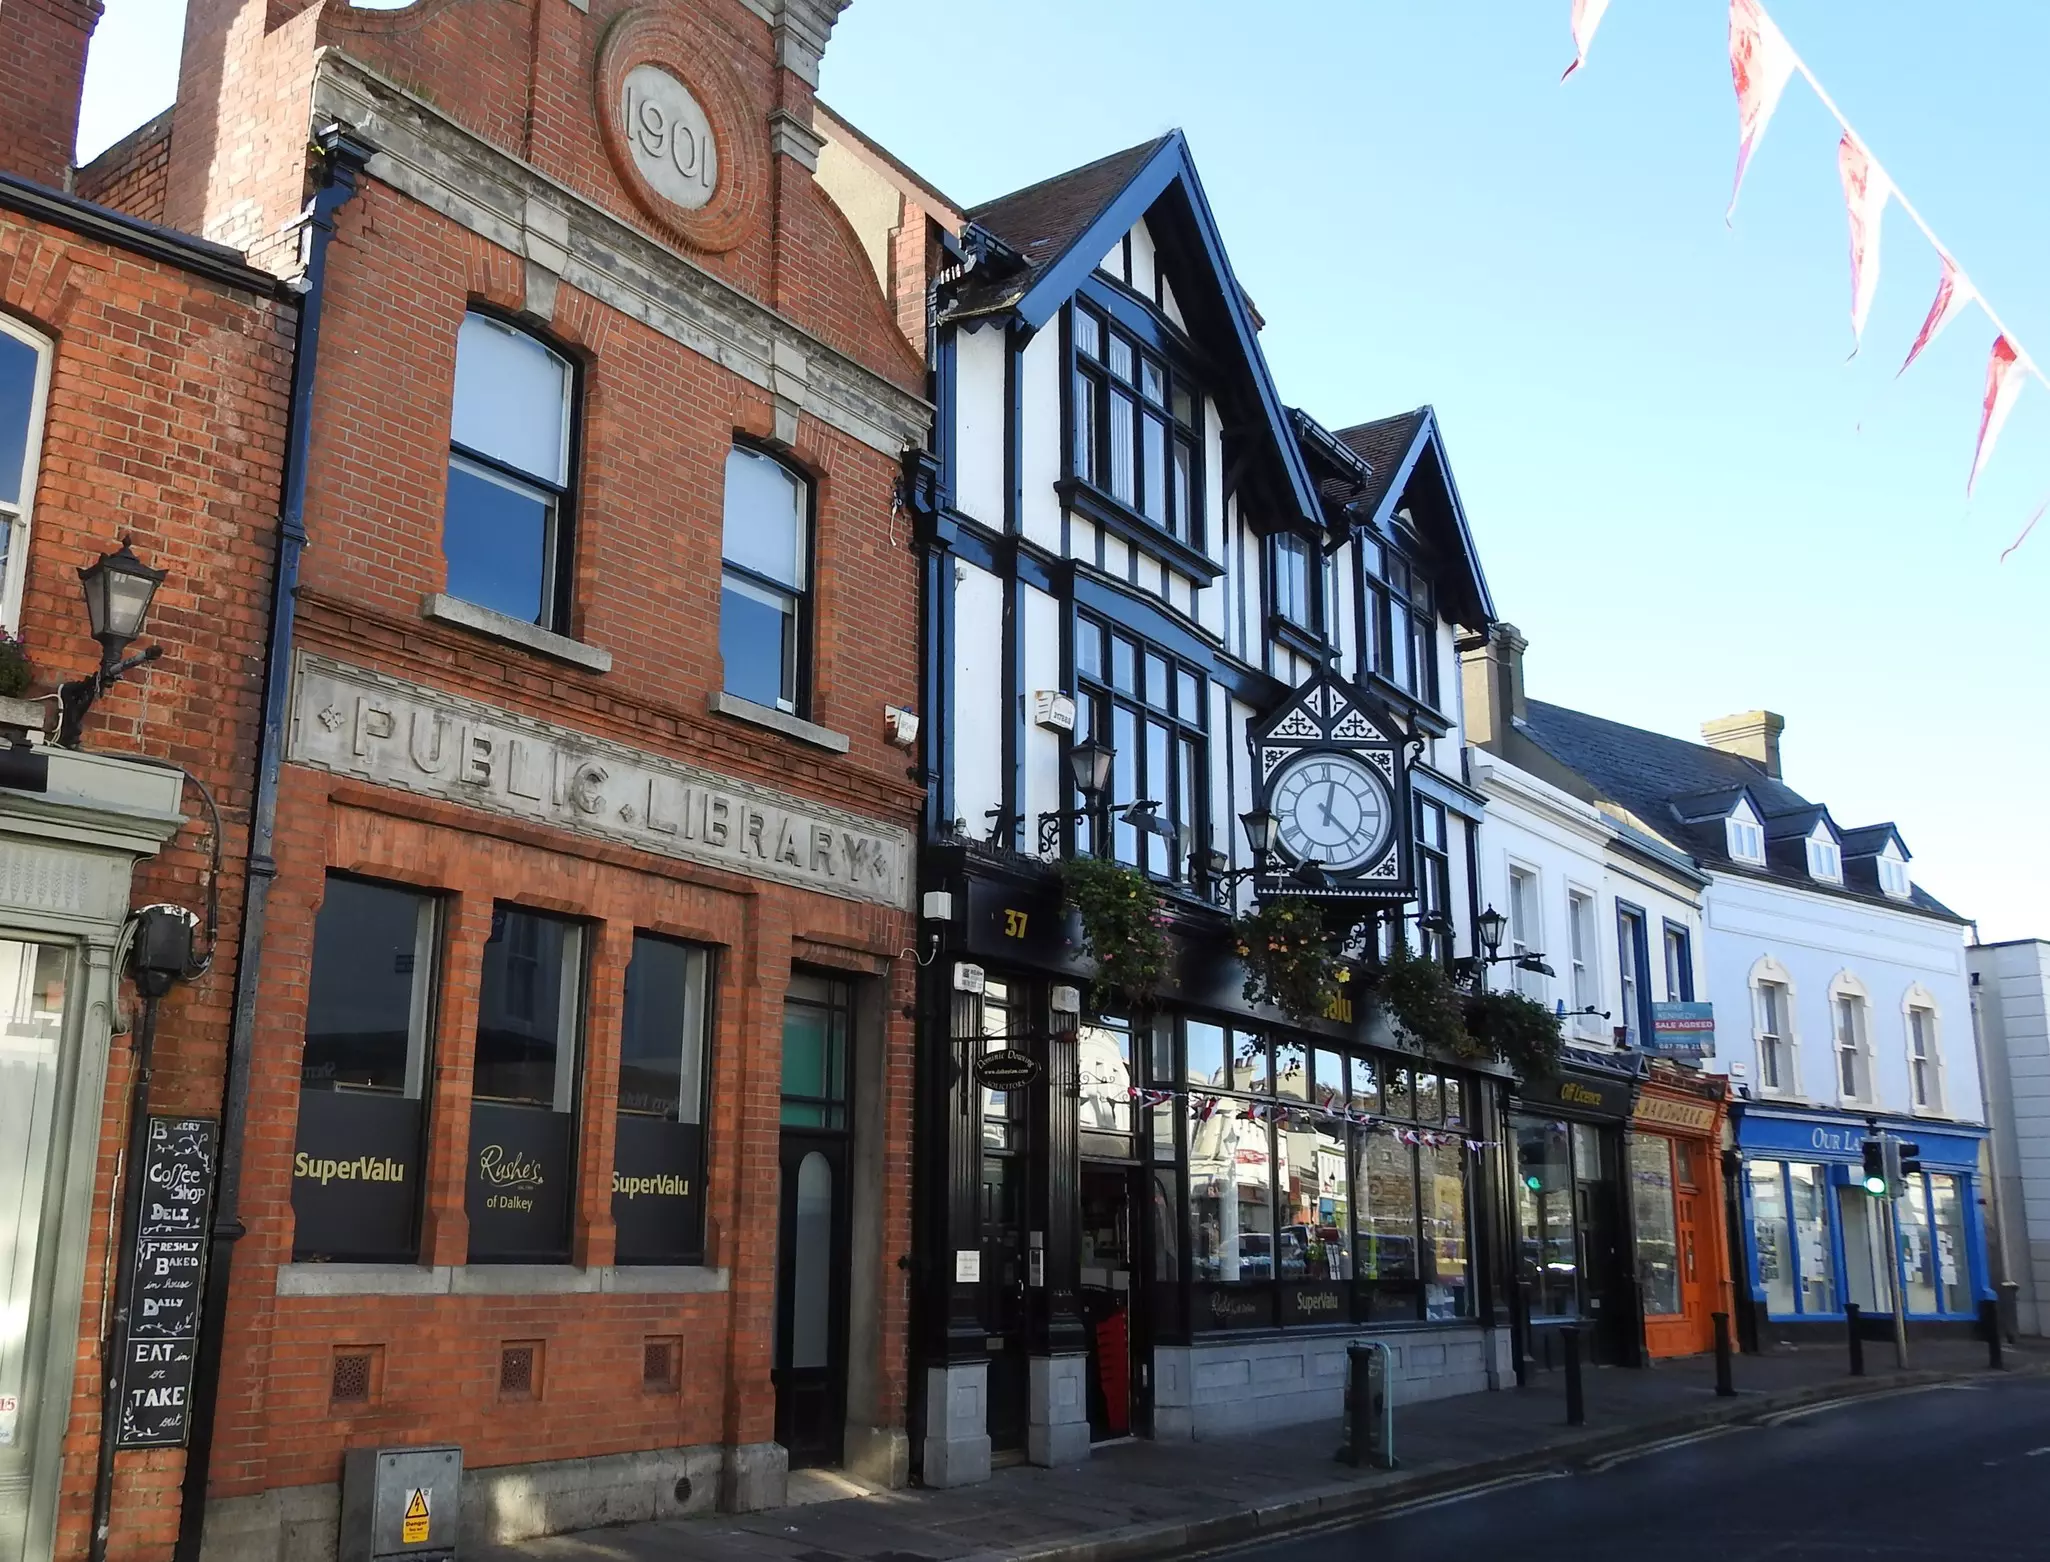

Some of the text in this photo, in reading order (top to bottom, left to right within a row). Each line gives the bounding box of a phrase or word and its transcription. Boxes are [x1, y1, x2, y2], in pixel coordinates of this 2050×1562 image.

[627, 86, 711, 189] 1901
[353, 696, 868, 881] PUBLIC LIBRARY
[1004, 909, 1028, 938] 37
[1655, 1021, 1676, 1029] SALE
[987, 1080, 1026, 1090] SOLICITORS
[1561, 1082, 1576, 1100] Off
[294, 1152, 404, 1186] SuperValu
[480, 1145, 541, 1183] Rushe's
[150, 1162, 200, 1190] Coffee
[612, 1170, 689, 1200] SuperValu
[171, 1184, 205, 1204] Shop
[151, 1203, 189, 1221] DELI
[486, 1195, 533, 1213] of Dalkey
[145, 1242, 199, 1260] FRESHLY
[154, 1257, 199, 1276] BAKED
[144, 1278, 193, 1290] in house
[143, 1298, 184, 1316] DAILY
[1297, 1292, 1338, 1315] SuperValu
[135, 1344, 190, 1362] EAT in
[148, 1369, 166, 1379] or
[132, 1386, 185, 1407] TAKE
[159, 1414, 183, 1427] out
